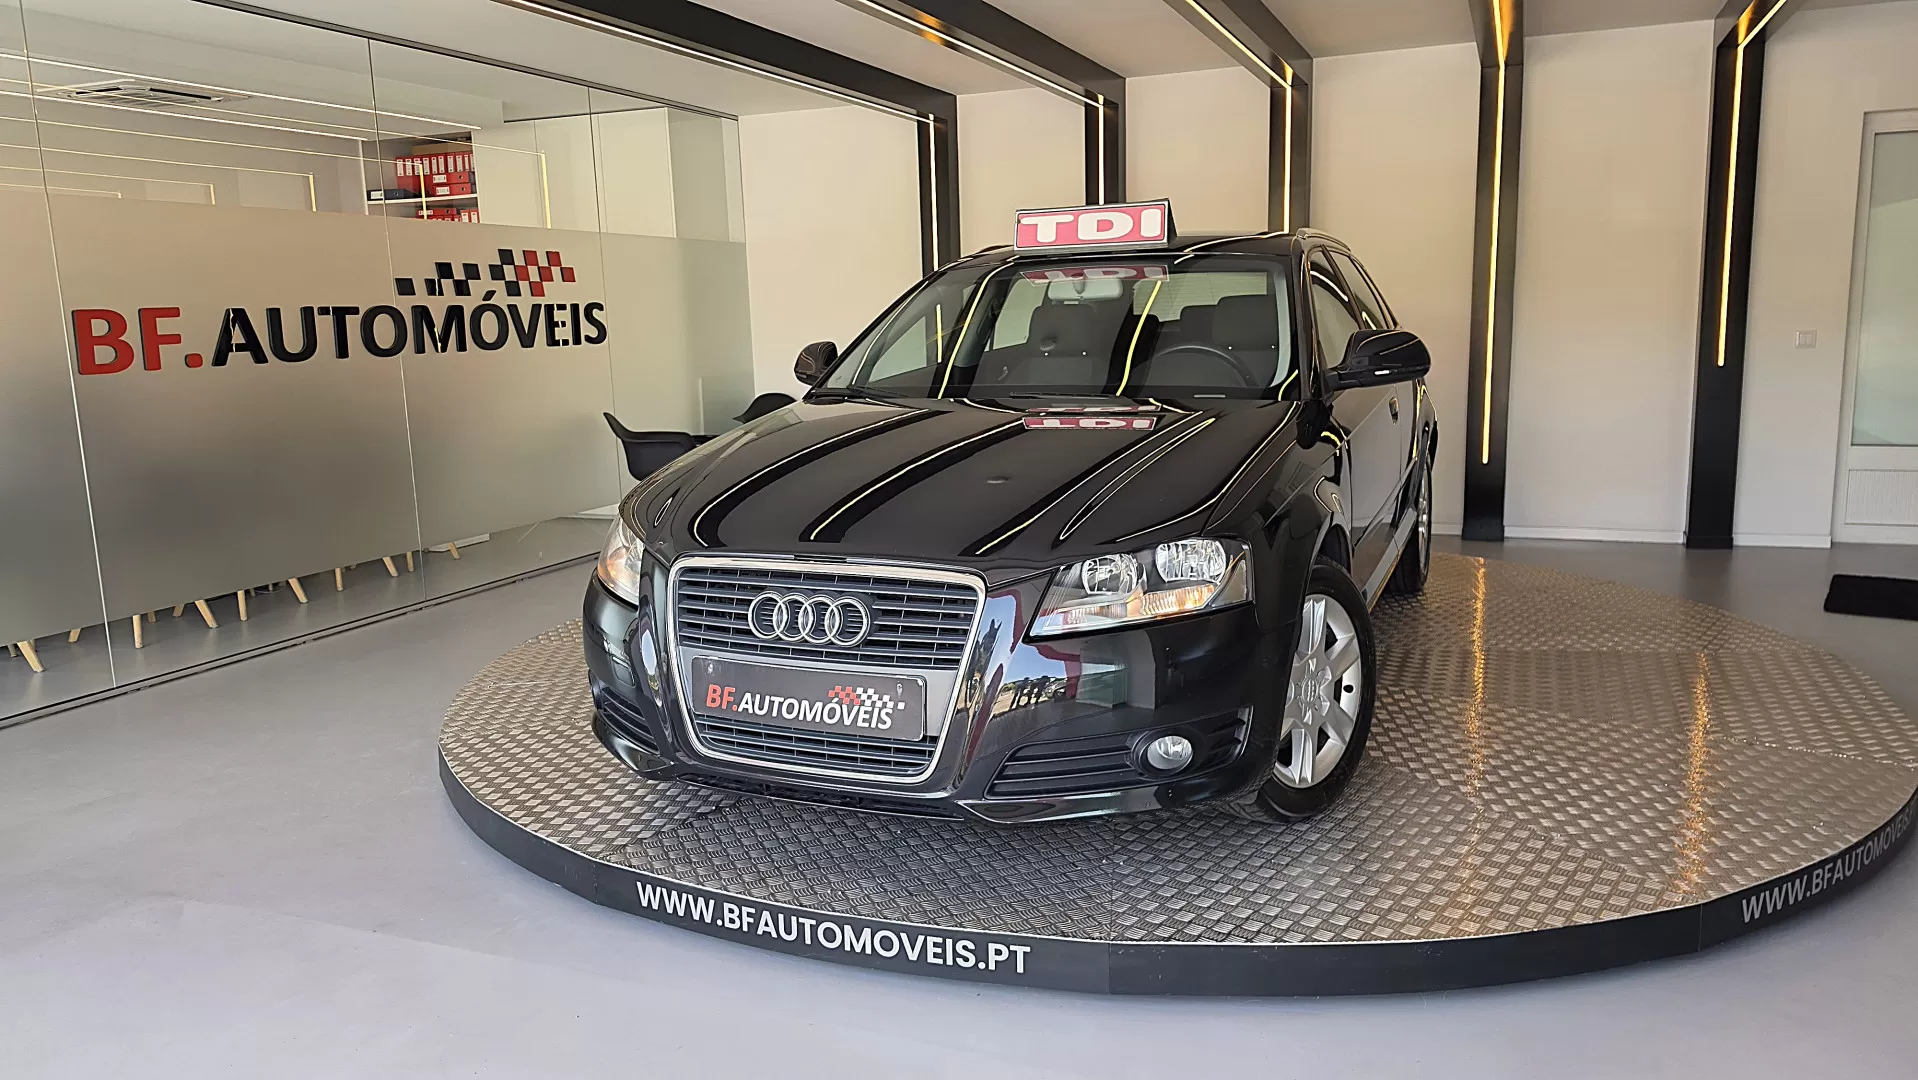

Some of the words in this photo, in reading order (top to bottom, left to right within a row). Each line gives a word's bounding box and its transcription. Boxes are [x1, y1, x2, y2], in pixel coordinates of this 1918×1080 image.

[1020, 208, 1162, 243] TDI
[73, 290, 608, 375] BF.AUTOMÓVEIS
[706, 684, 893, 730] BF.AUTOMÓVEIS
[636, 881, 1031, 974] WWW.BFAUTOMOVEIS.PT
